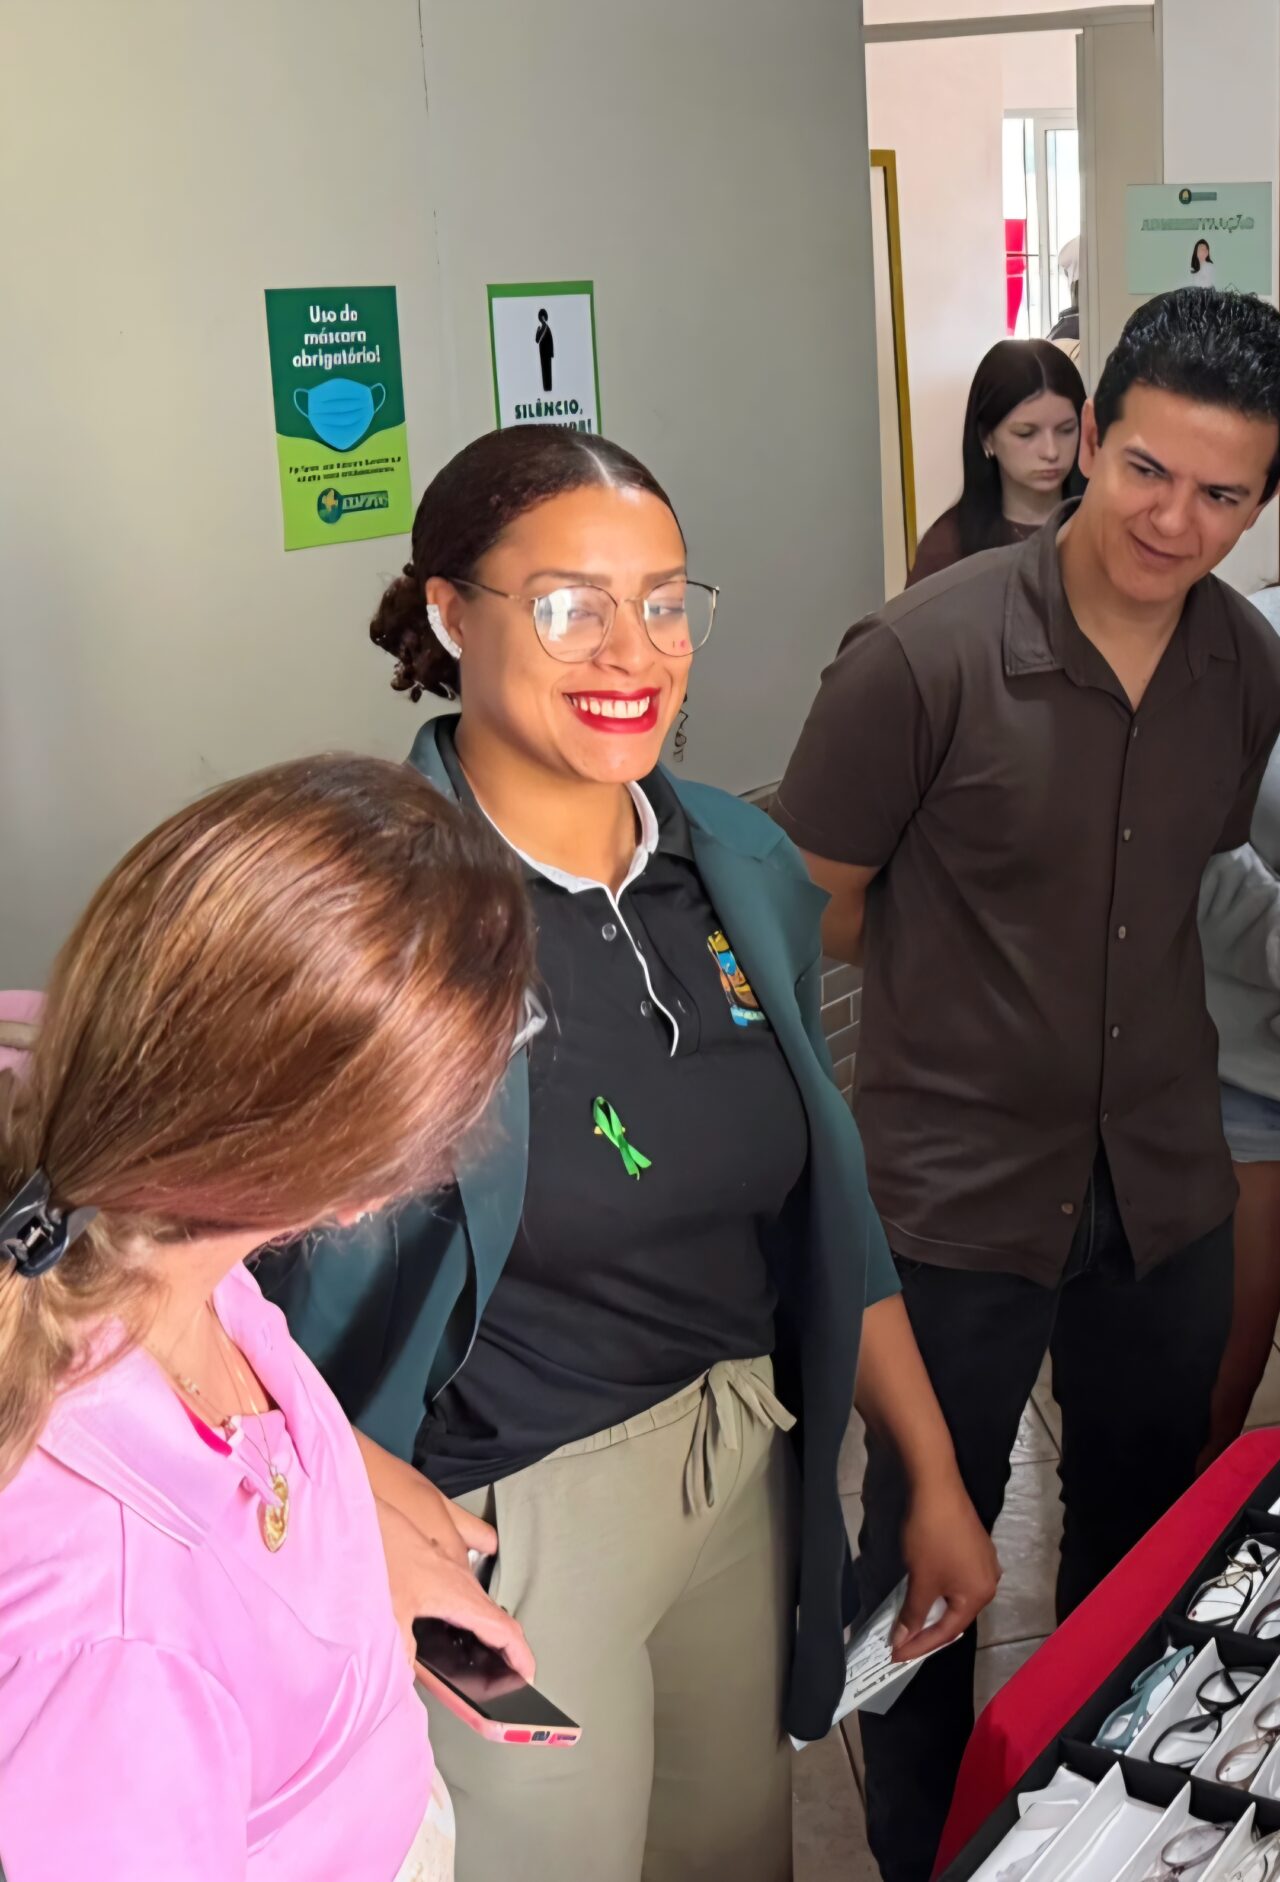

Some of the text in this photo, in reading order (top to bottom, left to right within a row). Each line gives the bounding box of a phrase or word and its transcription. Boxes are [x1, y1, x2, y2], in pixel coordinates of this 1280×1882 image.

[309, 305, 337, 323] Uso
[304, 327, 367, 345] máscara
[292, 344, 381, 370] obrigatório!
[514, 398, 583, 419] SILÊNCIO,
